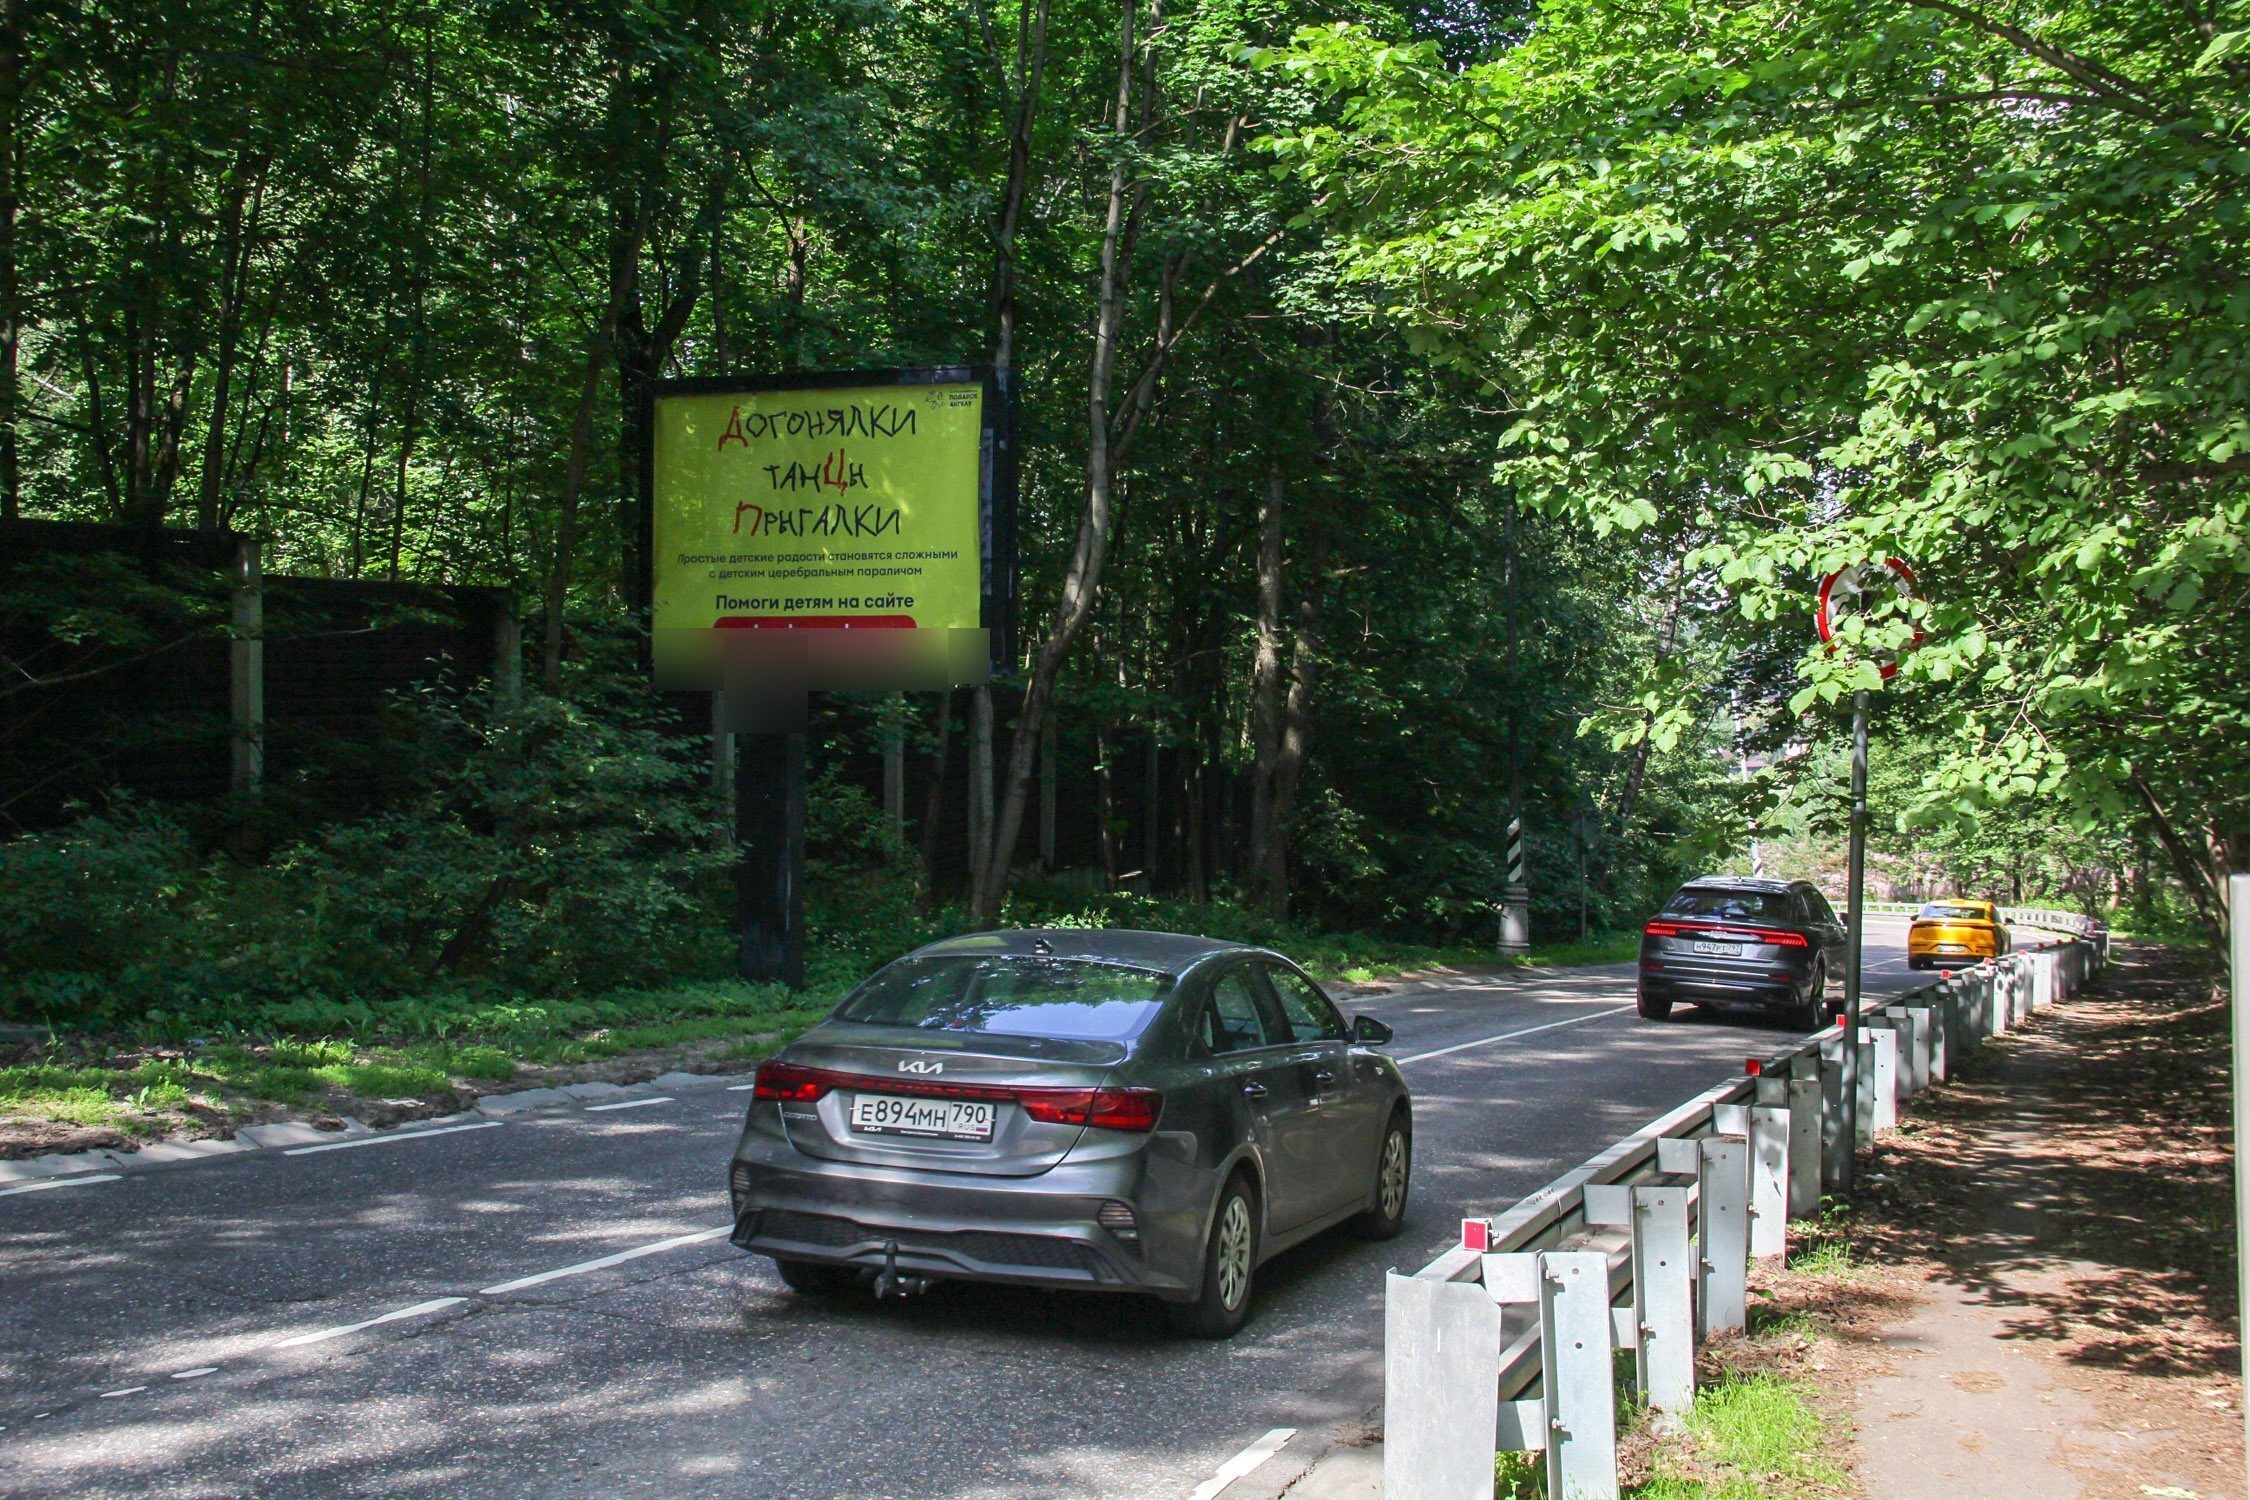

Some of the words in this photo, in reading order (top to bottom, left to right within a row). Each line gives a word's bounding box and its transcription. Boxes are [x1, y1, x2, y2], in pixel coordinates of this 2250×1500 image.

[677, 553, 726, 565] Простые
[729, 553, 774, 564] детские
[777, 552, 826, 564] радости
[829, 551, 893, 561] становятся
[895, 550, 958, 560] сложными
[708, 570, 716, 578] с
[719, 569, 765, 579] детским
[768, 567, 854, 579] церебральным
[857, 567, 922, 578] параличом
[716, 595, 779, 610] Помоги
[784, 597, 833, 611] детям
[838, 597, 859, 608] на
[864, 592, 914, 608] сайте
[898, 1060, 944, 1075] KIA
[783, 1111, 818, 1122] CTO
[953, 1104, 987, 1124] 790
